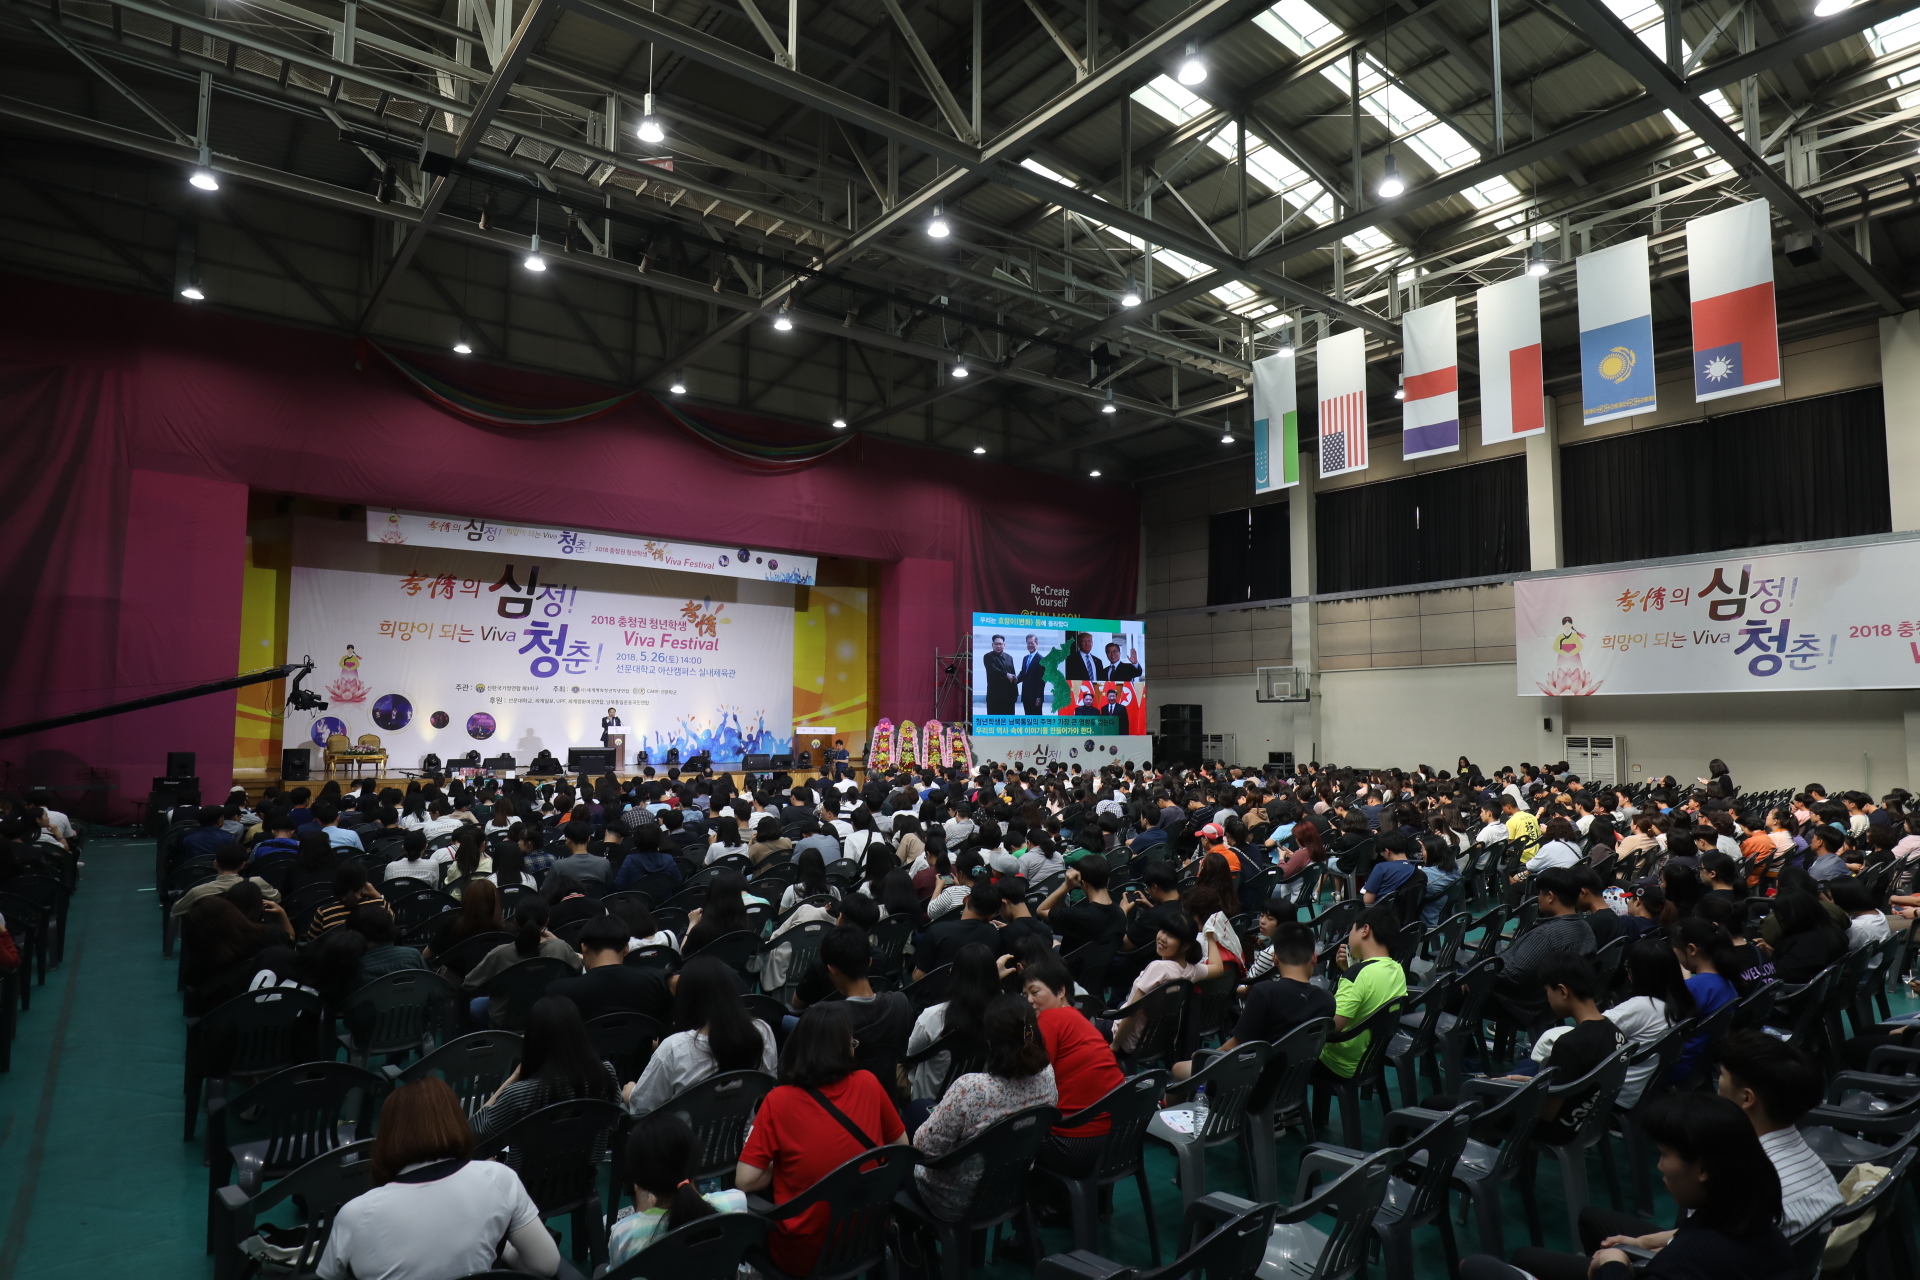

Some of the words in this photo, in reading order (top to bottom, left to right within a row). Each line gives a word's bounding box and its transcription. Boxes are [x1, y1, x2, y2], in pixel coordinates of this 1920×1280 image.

[464, 518, 502, 542] 심정!
[558, 530, 592, 554] 청춘!
[609, 548, 626, 556] 충청권
[626, 549, 648, 558] 청년학생
[665, 556, 682, 566] Viva
[683, 558, 715, 570] Festival
[399, 570, 482, 600] 孝情의
[488, 564, 578, 620] 심정!
[1030, 584, 1070, 596] Re-Create
[1615, 586, 1690, 612] 孝情의
[1698, 563, 1799, 621] 심정!
[1034, 596, 1068, 608] Yourself
[591, 616, 616, 626] 2018
[618, 616, 647, 628] 충청권
[649, 618, 687, 632] 청년학생
[980, 616, 996, 624] 우리는
[1849, 624, 1892, 638] 2018
[376, 620, 434, 642] 희망이
[438, 624, 474, 643] 되는
[480, 626, 517, 642] Viva
[518, 620, 604, 678] 청춘!
[624, 630, 656, 648] Viva
[660, 633, 720, 651] Festival
[1600, 634, 1648, 652] 희망이
[1652, 630, 1688, 648] 되는
[1692, 629, 1731, 646] Viva
[1733, 618, 1838, 677] 청춘!
[616, 652, 638, 662] 2018.
[680, 656, 702, 664] 14:00
[616, 664, 656, 674] 선문대학교
[658, 667, 697, 676] 아산캠퍼스
[698, 668, 736, 678] 실내체육관
[1032, 744, 1062, 766] 심정!
